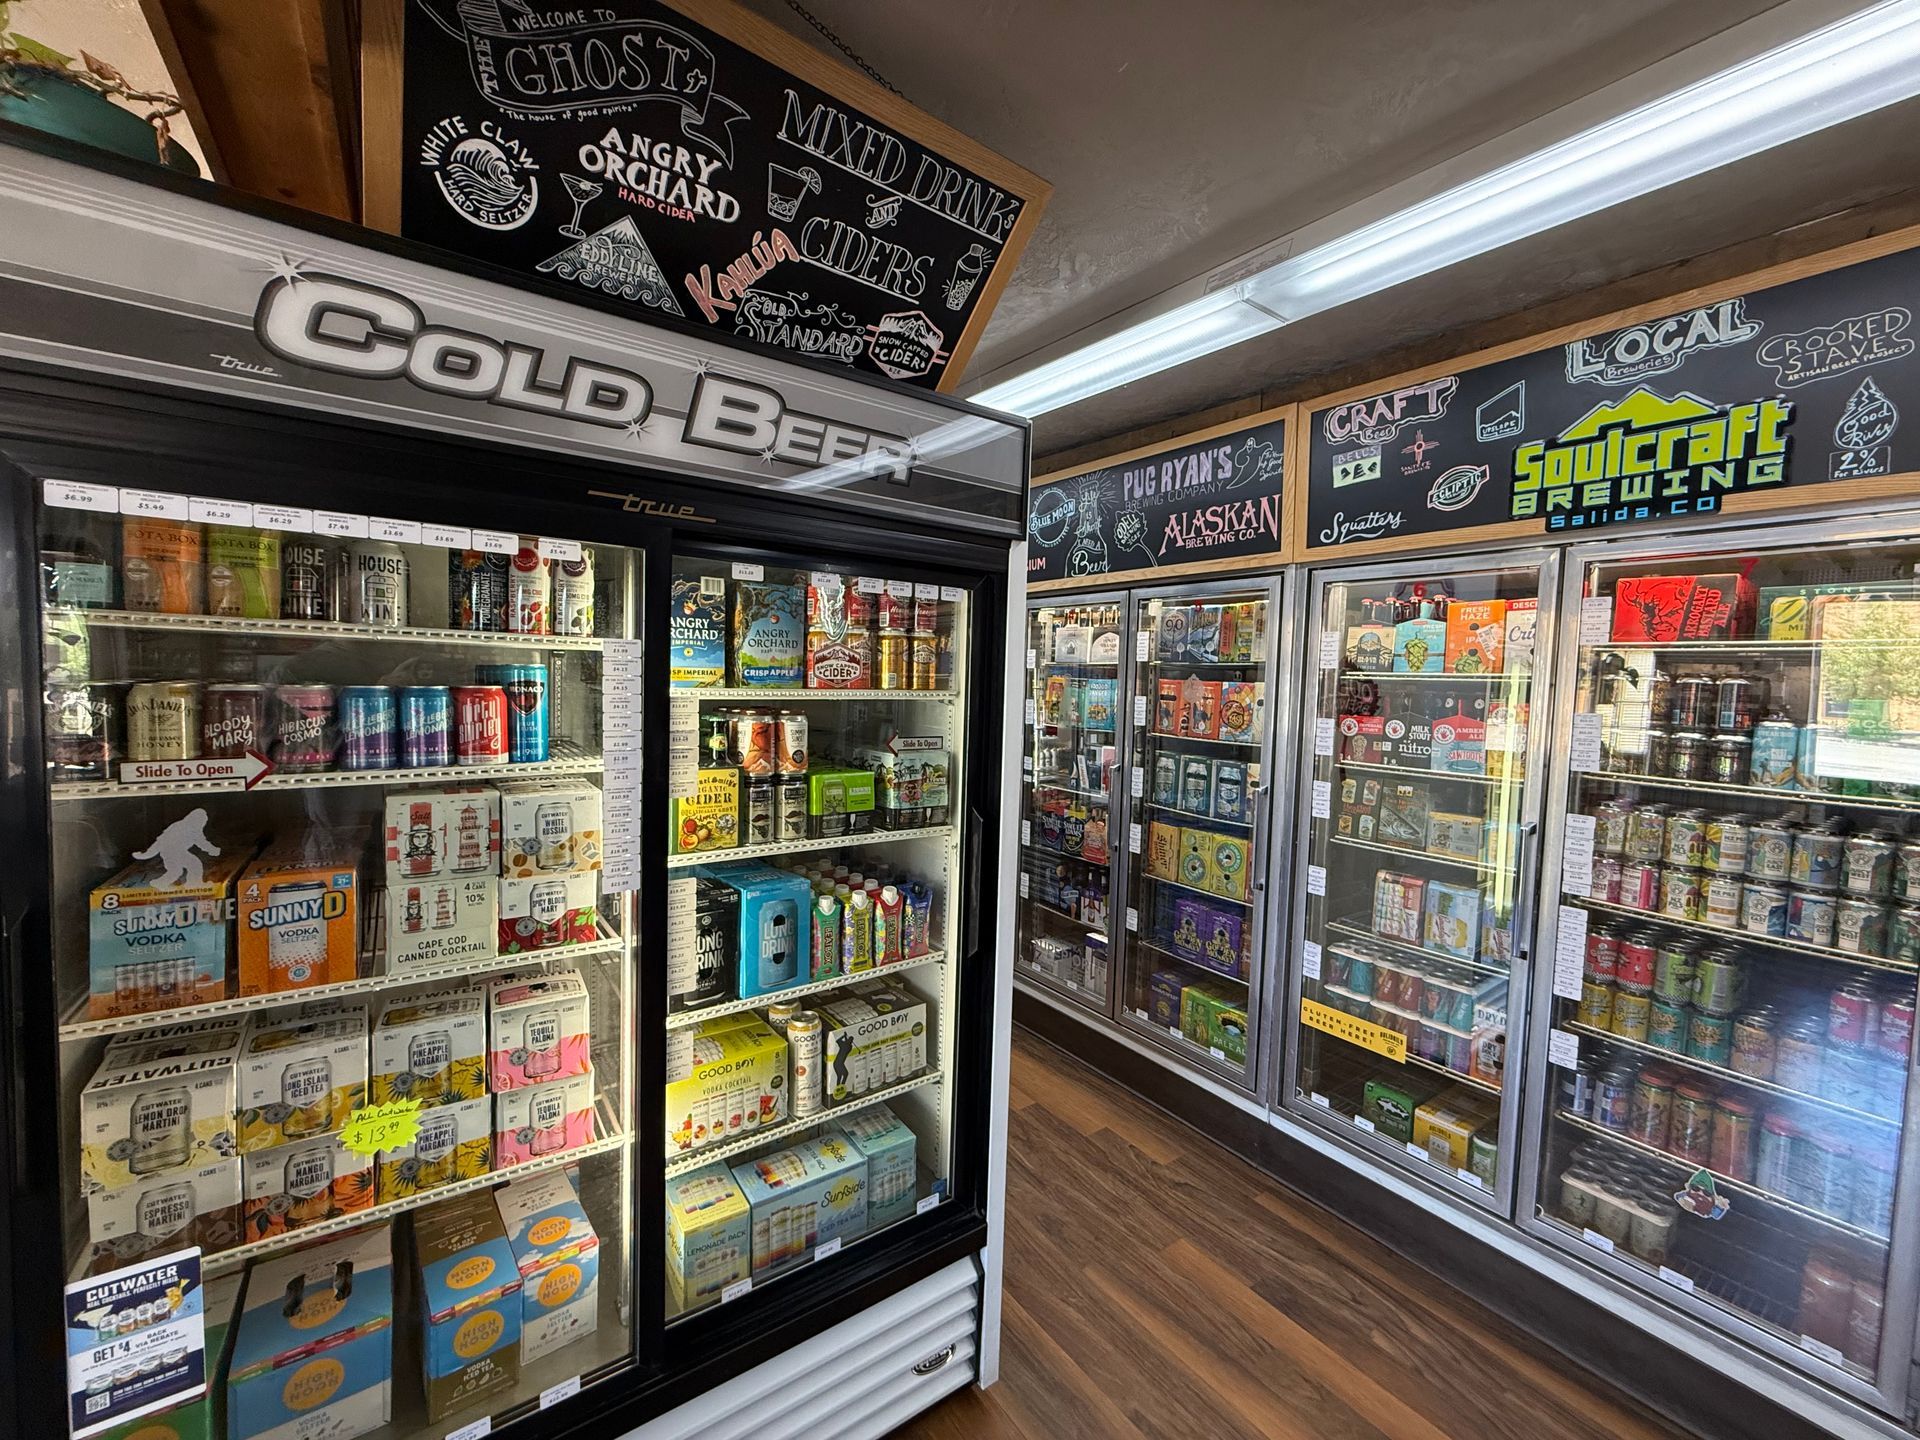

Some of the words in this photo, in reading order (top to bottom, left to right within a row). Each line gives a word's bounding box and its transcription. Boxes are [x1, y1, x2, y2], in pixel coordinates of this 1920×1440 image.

[513, 12, 588, 32] WELCOME
[593, 8, 617, 22] TO
[472, 34, 500, 94] THE
[505, 33, 690, 95] GHOST
[577, 108, 599, 122] good
[420, 115, 469, 167] WHITE
[480, 121, 540, 171] CLAW
[777, 89, 907, 186] MIXED
[600, 127, 722, 186] ANGRY
[579, 144, 741, 223] ORCHARD
[444, 179, 474, 213] HARD
[479, 192, 533, 223] SELTZER
[618, 187, 655, 208] HARD
[657, 203, 696, 223] CIDER
[870, 204, 900, 224] AND
[579, 236, 660, 283] EDDYLINE
[802, 217, 936, 297] CIDERS
[586, 262, 641, 286] BREWERY
[744, 301, 864, 362] STANDARD
[1570, 300, 1750, 379] LOCAL
[1762, 313, 1904, 362] CROOKED
[879, 336, 902, 348] SNOW
[902, 341, 929, 358] CAPPED
[1785, 336, 1888, 374] STAVE
[210, 352, 281, 377] true
[878, 347, 922, 370] CIDER
[1606, 353, 1671, 378] Breweries
[1787, 365, 1829, 382] ARTISAN
[1831, 358, 1860, 371] BEER
[1863, 345, 1907, 361] PROJECT
[254, 272, 653, 430] COLD
[684, 374, 914, 484] BEER
[1329, 376, 1453, 438] CRAFT
[1365, 427, 1391, 440] Beer
[1481, 421, 1516, 435] UPSLOPE
[1513, 398, 1794, 493] Soulcraft
[1839, 447, 1879, 470] 2%
[1123, 465, 1156, 501] PUG
[1160, 445, 1233, 493] RYAN'S
[1125, 493, 1164, 511] BREWING
[1167, 481, 1224, 502] COMPANY
[1432, 472, 1482, 502] ECLIPTIC
[1512, 454, 1786, 517] BREWING
[64, 494, 93, 503] $6.99
[137, 502, 165, 512] $5.49
[1031, 514, 1051, 531] BLUE
[1052, 500, 1074, 522] MOON
[1550, 505, 1662, 529] Salida,
[1670, 495, 1716, 514] CO
[1116, 514, 1139, 538] ODELL
[1158, 494, 1281, 557] ALASKAN
[1320, 512, 1406, 544] Squatters
[1185, 535, 1235, 549] BREWING
[1239, 528, 1256, 541] CO.
[358, 555, 402, 576] HOUSE
[1799, 586, 1867, 596] STONE
[1460, 606, 1491, 614] FRESH
[1460, 612, 1491, 621] HAZE
[1683, 585, 1709, 639] ARROGANT
[1697, 589, 1722, 638] BASTARD
[1714, 602, 1732, 628] ALE
[748, 638, 799, 649] ORCHARD
[755, 629, 791, 640] ANGRY
[744, 669, 769, 677] CRISP
[769, 668, 796, 677] APPLE
[822, 667, 853, 678] CIDER
[204, 716, 253, 738] BLOODY
[279, 715, 327, 735] HIBISCUS
[1411, 725, 1430, 734] MILK
[1456, 727, 1486, 735] AMBER
[212, 729, 256, 750] MARY
[283, 727, 322, 746] COSMO
[902, 740, 916, 748] Slide
[923, 740, 938, 749] Open
[1408, 732, 1432, 742] STOUT
[136, 764, 172, 778] Slide
[178, 764, 192, 777] To
[196, 762, 234, 780] Open
[685, 792, 733, 806] CIDER
[542, 826, 568, 836] RUSSIAN
[545, 819, 565, 828] WHITE
[246, 883, 260, 897] 4
[466, 892, 485, 902] 10%
[125, 932, 187, 948] VODKA
[279, 926, 320, 938] VODKA
[418, 941, 443, 951] CAPE
[447, 934, 467, 946] COD
[127, 943, 184, 956] SELTZER
[397, 949, 438, 964] CANNED
[441, 943, 487, 958] COCKTAIL
[857, 1017, 889, 1036] GOOD
[890, 1011, 909, 1029] BOY
[1303, 1005, 1376, 1038] GLUTEN-FREE
[1477, 1008, 1500, 1025] DRY
[530, 1026, 555, 1037] TEQUILA
[1309, 1015, 1335, 1030] BEER
[1340, 1027, 1374, 1046] HERE!
[411, 1044, 449, 1058] PINEAPPLE
[412, 1053, 449, 1068] MARGARITA
[91, 1055, 232, 1091] CUTWATER
[698, 1064, 733, 1080] GOOD
[735, 1057, 756, 1071] BOY
[134, 1109, 163, 1126] LEMON
[166, 1104, 189, 1119] DROP
[142, 1116, 181, 1133] MARTINI
[355, 1106, 374, 1123] ALL
[288, 1172, 331, 1190] MARGARITA
[295, 1163, 325, 1178] MANGO
[820, 1180, 867, 1209] Surfside
[144, 1201, 190, 1220] ESPRESSO
[686, 1237, 727, 1257] LEMONADE
[727, 1229, 747, 1242] PACK
[86, 1265, 179, 1302] CUTWATER
[542, 1280, 579, 1301] NOON
[545, 1271, 577, 1291] HIGH
[147, 1328, 168, 1340] BACK
[463, 1317, 498, 1336] HIGH
[135, 1340, 148, 1349] VIA
[150, 1330, 179, 1345] REBATE
[459, 1328, 501, 1352] NOON
[93, 1346, 116, 1364] GET
[119, 1340, 131, 1354] $4
[466, 1358, 492, 1374] VODKA
